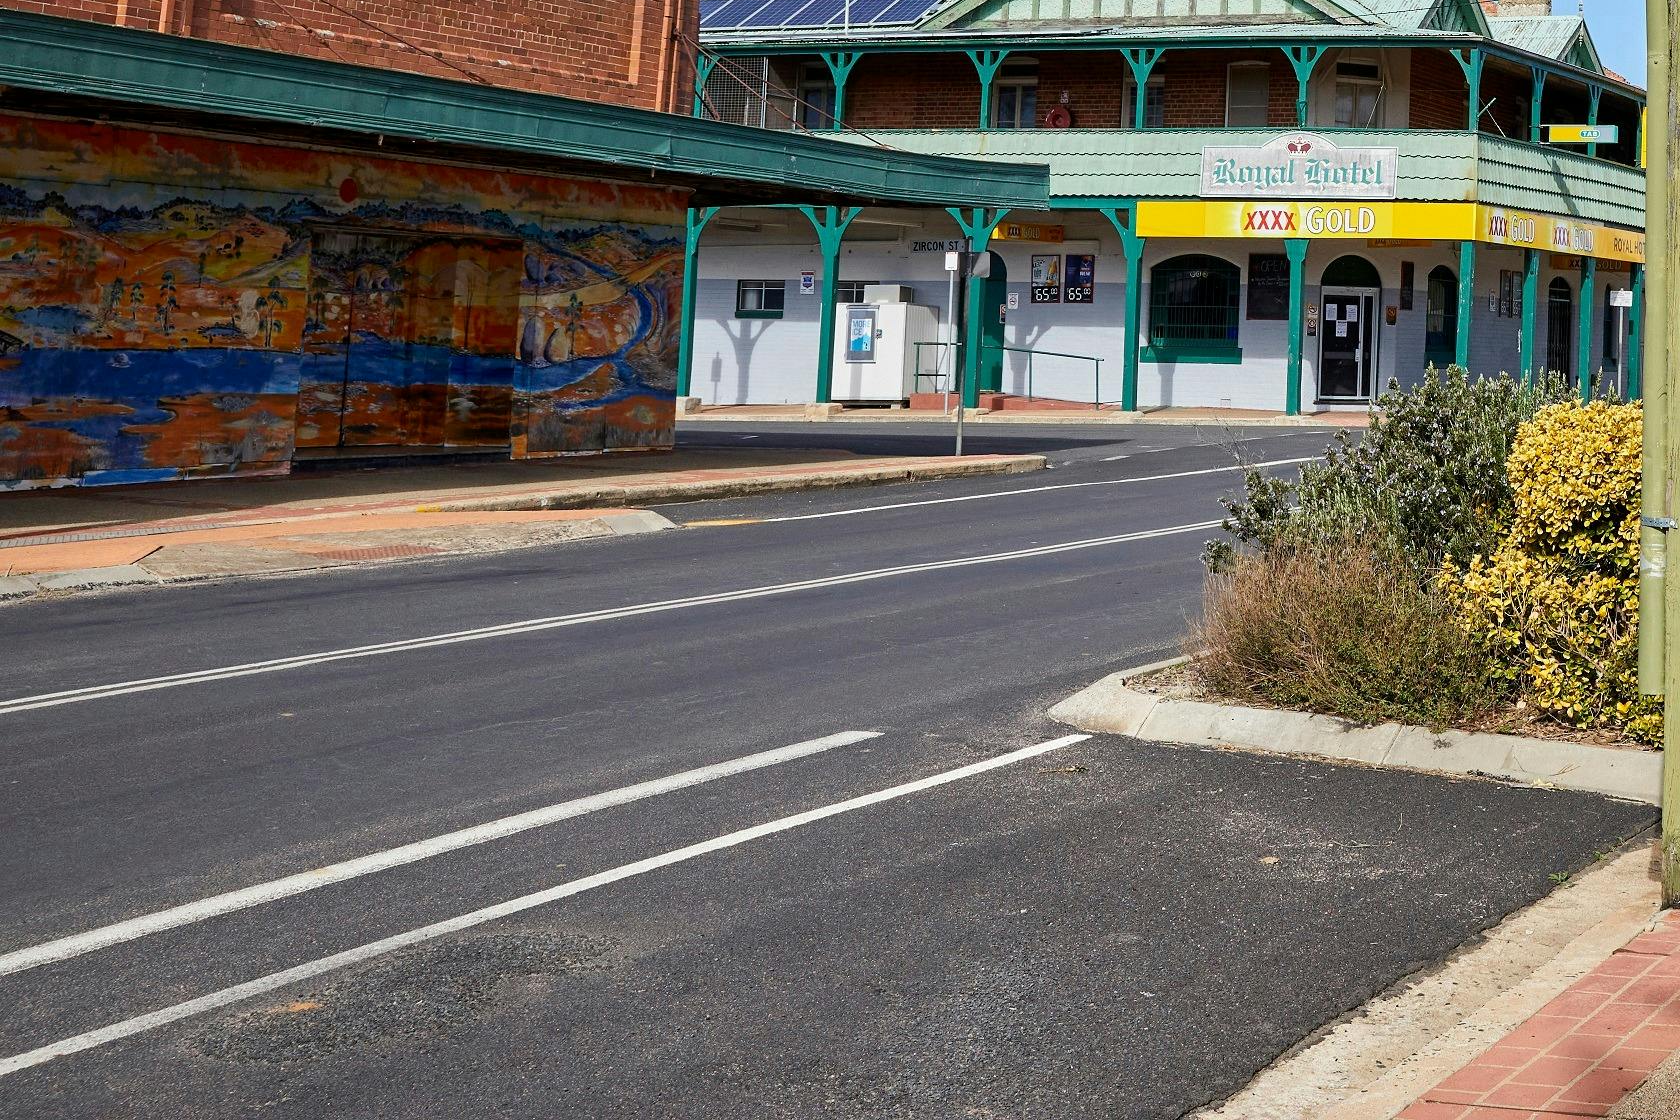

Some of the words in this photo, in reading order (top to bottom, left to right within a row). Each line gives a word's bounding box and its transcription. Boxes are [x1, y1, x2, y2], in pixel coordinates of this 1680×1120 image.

[1213, 158, 1295, 190] Royal
[1304, 158, 1384, 192] Hotel
[1243, 211, 1297, 230] XXXX
[1305, 206, 1376, 234] GOLD
[1488, 216, 1508, 238] XXXX
[1511, 214, 1535, 243] GOLD
[913, 241, 944, 251] ZIRCON
[949, 241, 959, 250] ST
[1573, 226, 1594, 252] GOLD
[1613, 237, 1633, 253] ROYAL
[853, 320, 871, 328] MORE
